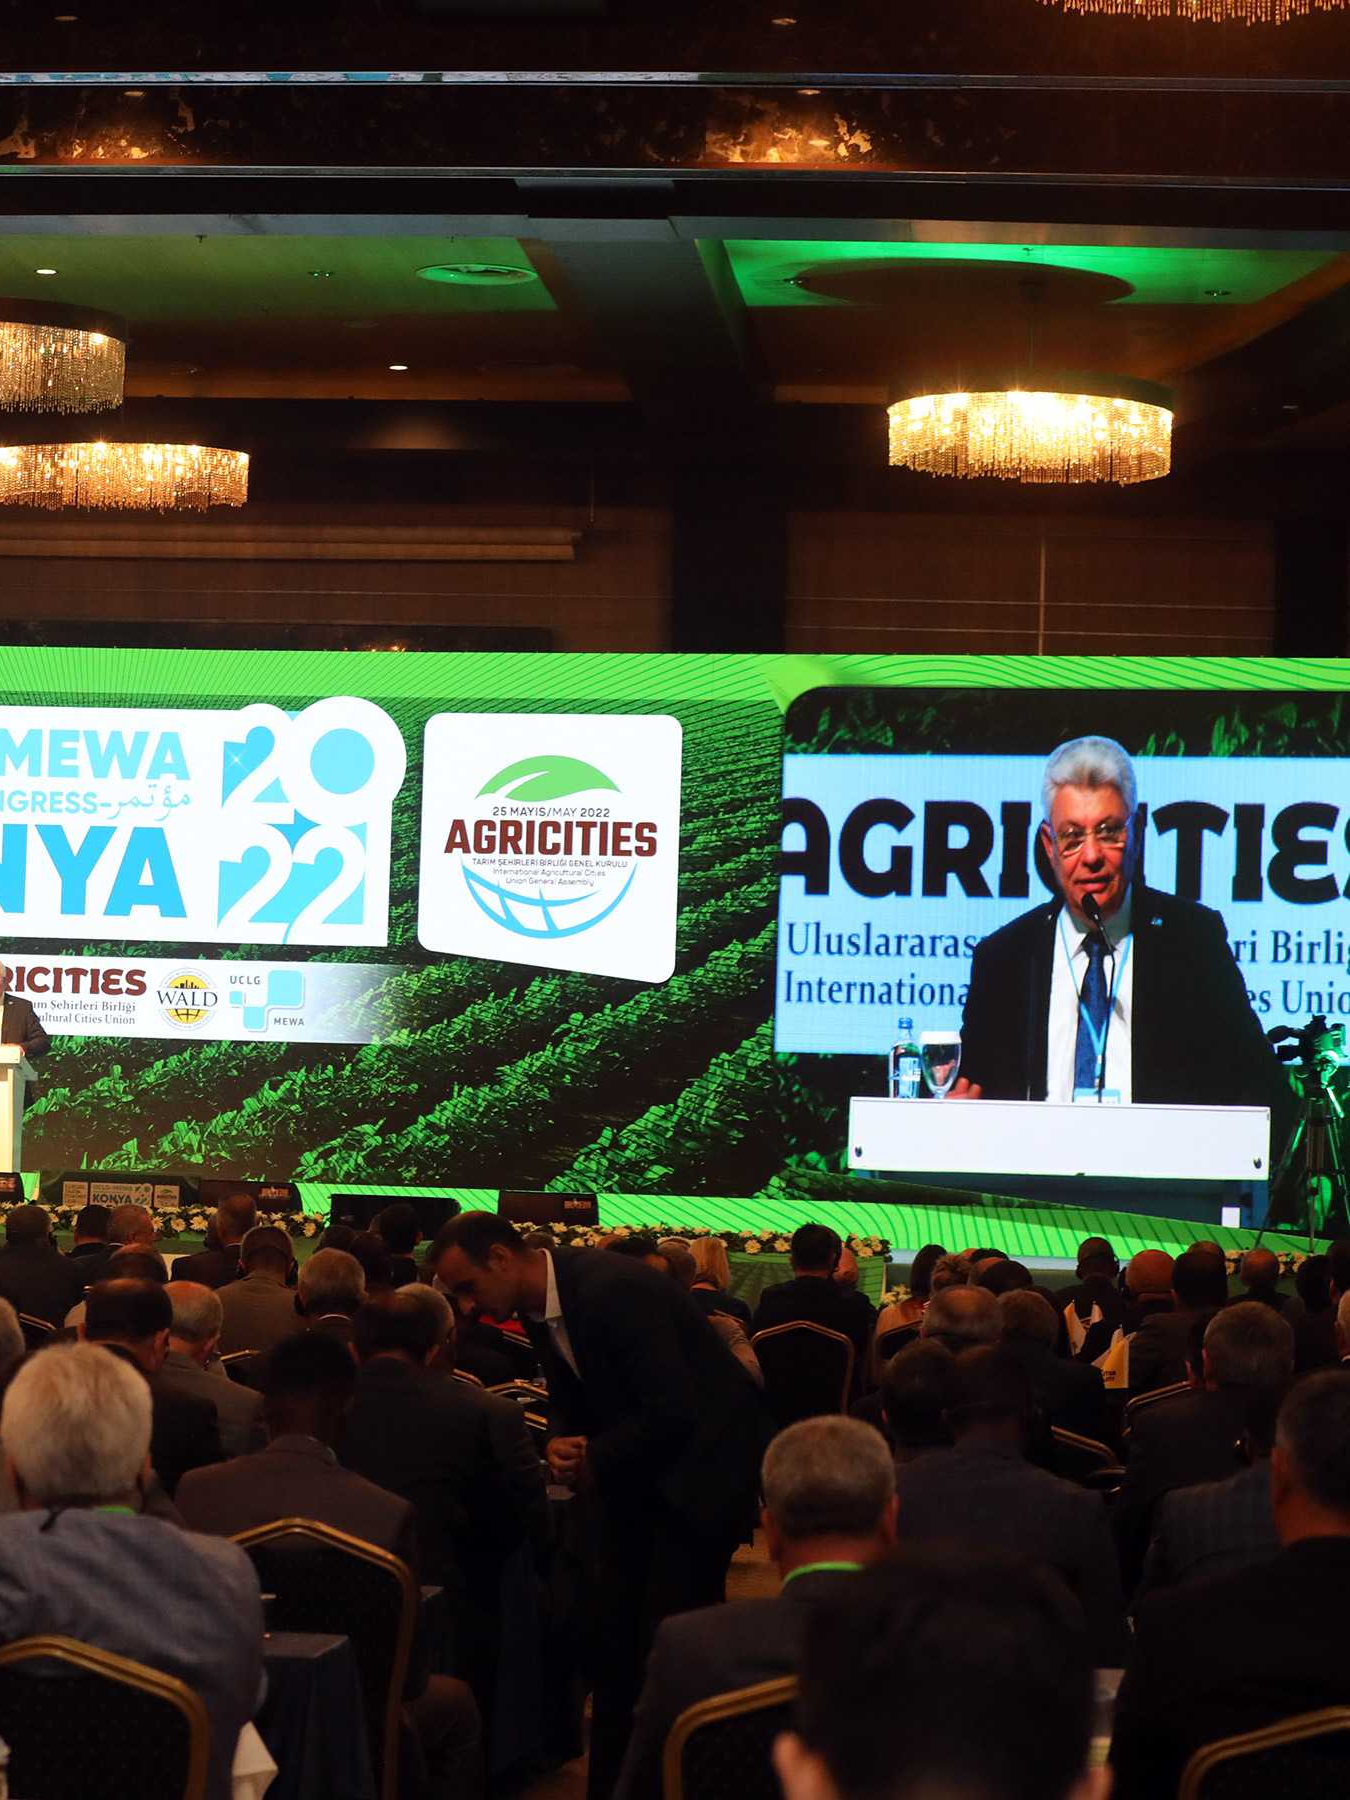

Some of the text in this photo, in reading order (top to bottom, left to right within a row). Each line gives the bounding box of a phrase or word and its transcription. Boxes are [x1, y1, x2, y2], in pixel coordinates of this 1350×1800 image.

[492, 806, 610, 818] 25 MAYIS/MAY 2022
[444, 819, 658, 857] AGRICITIES
[780, 796, 1350, 905] AGRITIE
[472, 858, 496, 866] TARIM
[569, 859, 594, 867] GENEL
[596, 860, 628, 868] KURULU
[493, 868, 539, 876] International
[505, 877, 527, 885] Union
[558, 878, 594, 887] Assembly
[1271, 929, 1350, 975] Birli
[229, 975, 261, 985] UCLG
[784, 970, 971, 1006] Internationa
[157, 990, 218, 1007] WALD
[1281, 980, 1350, 1015] Unio
[50, 999, 98, 1011] Şehirleri
[102, 1001, 136, 1014] Birliği
[74, 1013, 103, 1023] Cities
[105, 1014, 135, 1024] Union
[273, 1017, 305, 1026] MEWA
[93, 1193, 132, 1204] KONYA
